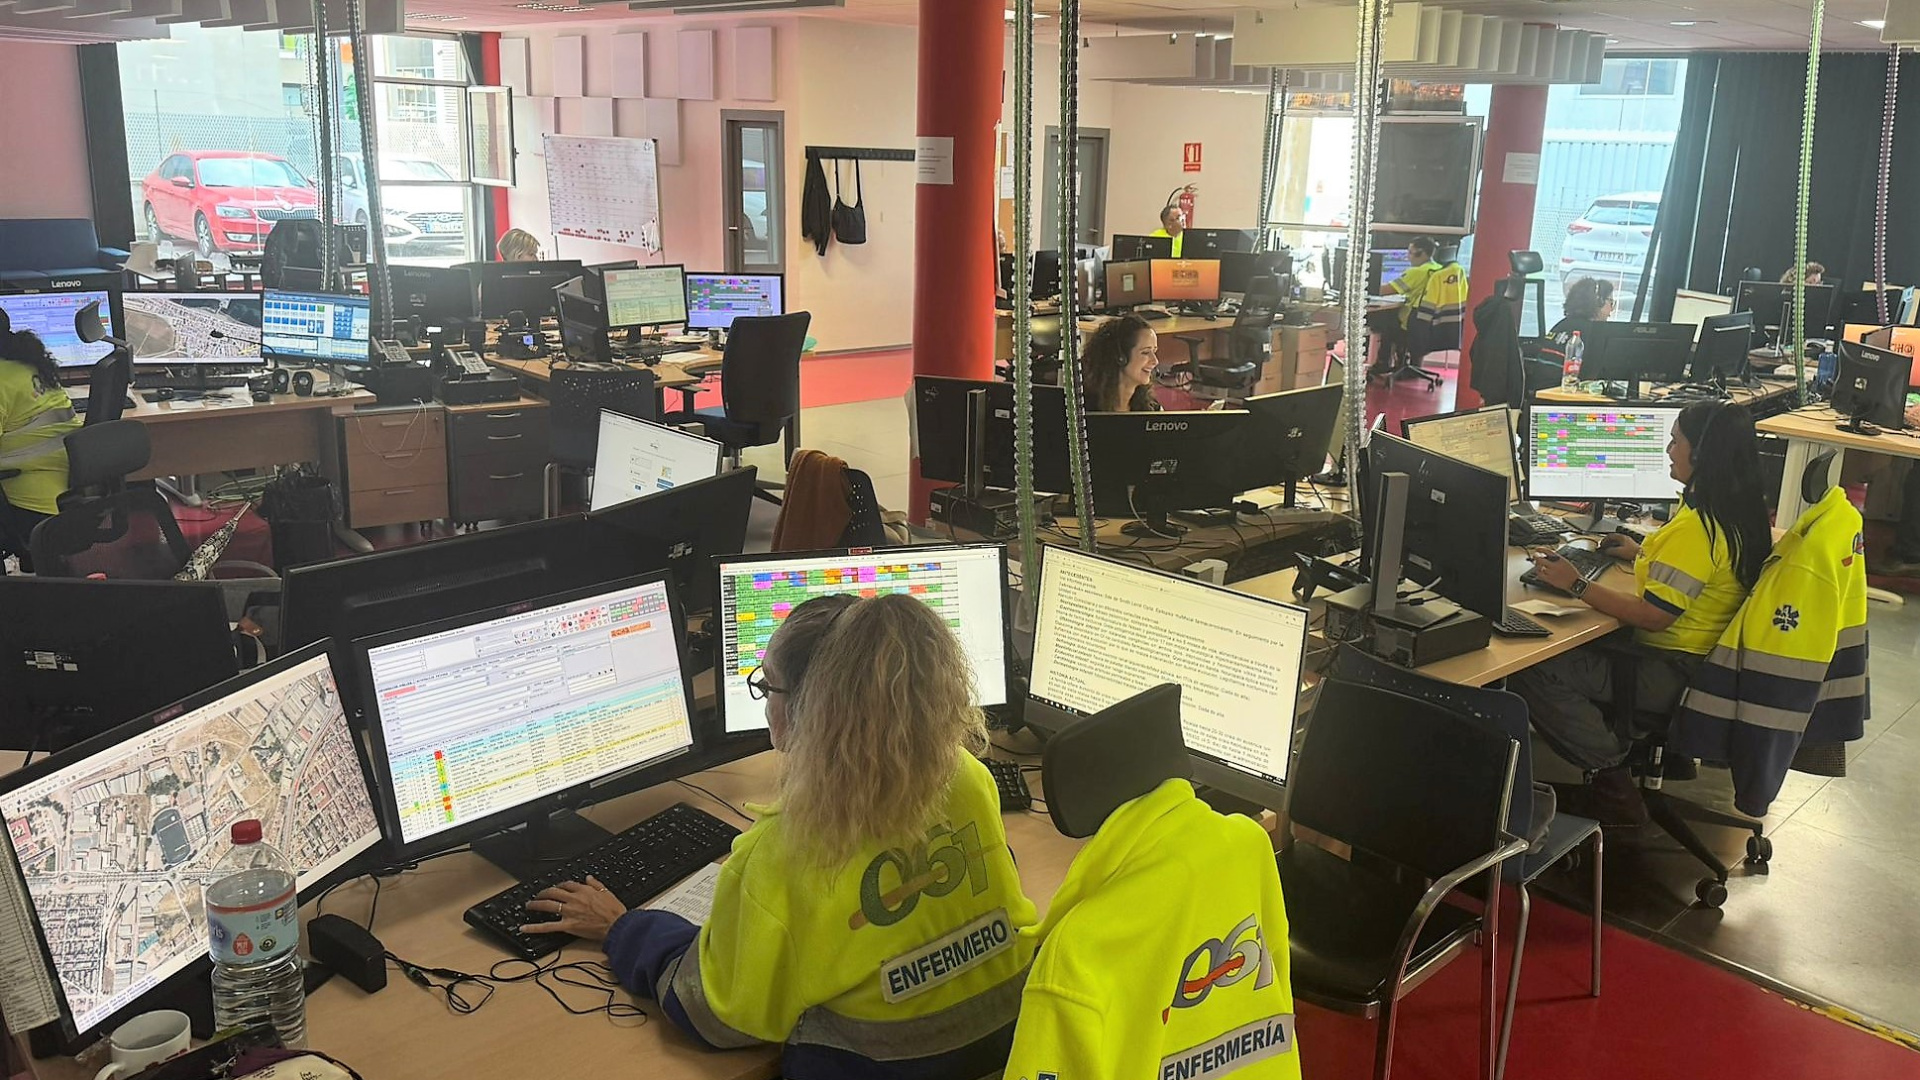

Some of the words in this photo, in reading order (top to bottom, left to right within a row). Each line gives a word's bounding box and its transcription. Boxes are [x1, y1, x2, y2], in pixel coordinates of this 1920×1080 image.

[51, 280, 82, 288] Lenovo
[1145, 420, 1189, 431] Lenovo
[888, 919, 1008, 996] ENFERMERO
[1172, 913, 1274, 1009] 061
[1163, 1021, 1286, 1080] ENFERMERÍA
